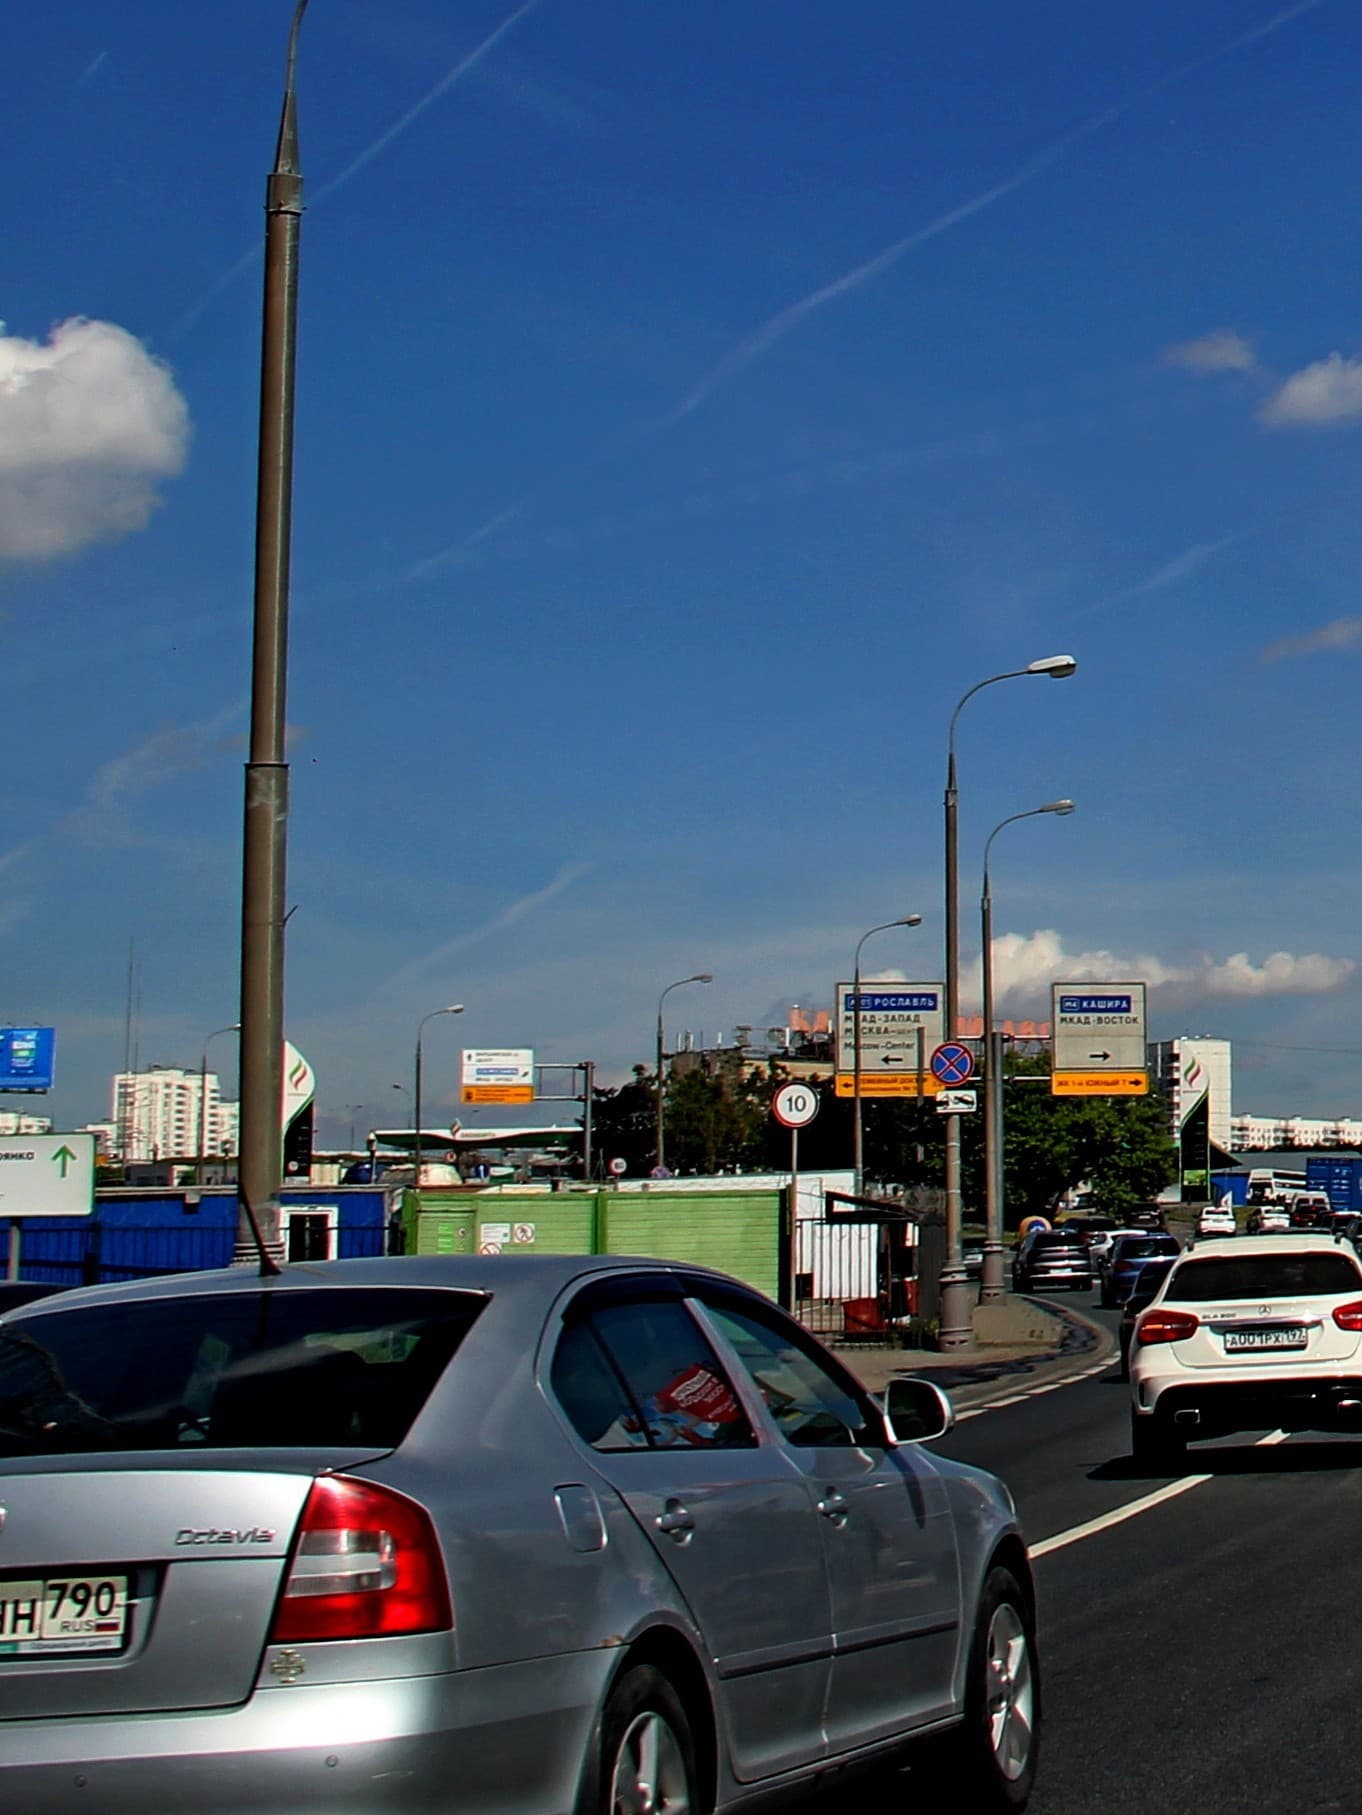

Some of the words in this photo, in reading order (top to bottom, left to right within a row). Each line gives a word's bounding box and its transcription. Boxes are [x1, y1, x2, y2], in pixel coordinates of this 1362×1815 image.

[874, 997, 935, 1007] РОСЛАВЛЬ
[1082, 1000, 1128, 1009] КАШИРА
[844, 1014, 921, 1024] МАД-ЗАПАД
[786, 1095, 806, 1113] 10
[175, 1528, 276, 1545] Octavia
[47, 1582, 115, 1619] 790
[61, 1620, 96, 1632] RUS
